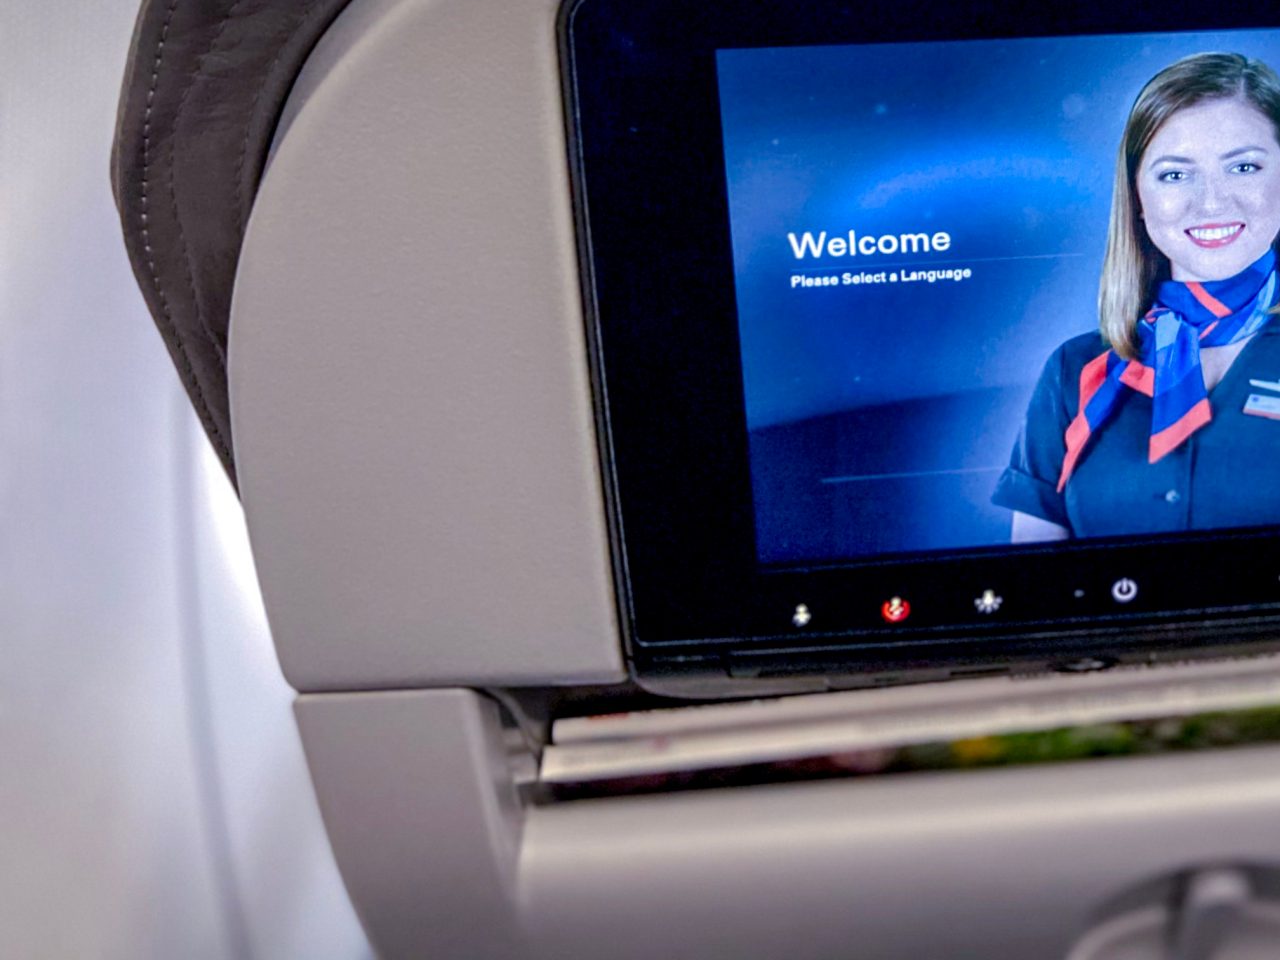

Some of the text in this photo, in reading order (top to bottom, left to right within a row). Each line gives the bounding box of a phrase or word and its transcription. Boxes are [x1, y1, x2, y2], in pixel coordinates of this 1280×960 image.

[788, 230, 950, 259] Welcome
[791, 268, 972, 288] Please Select a Language
